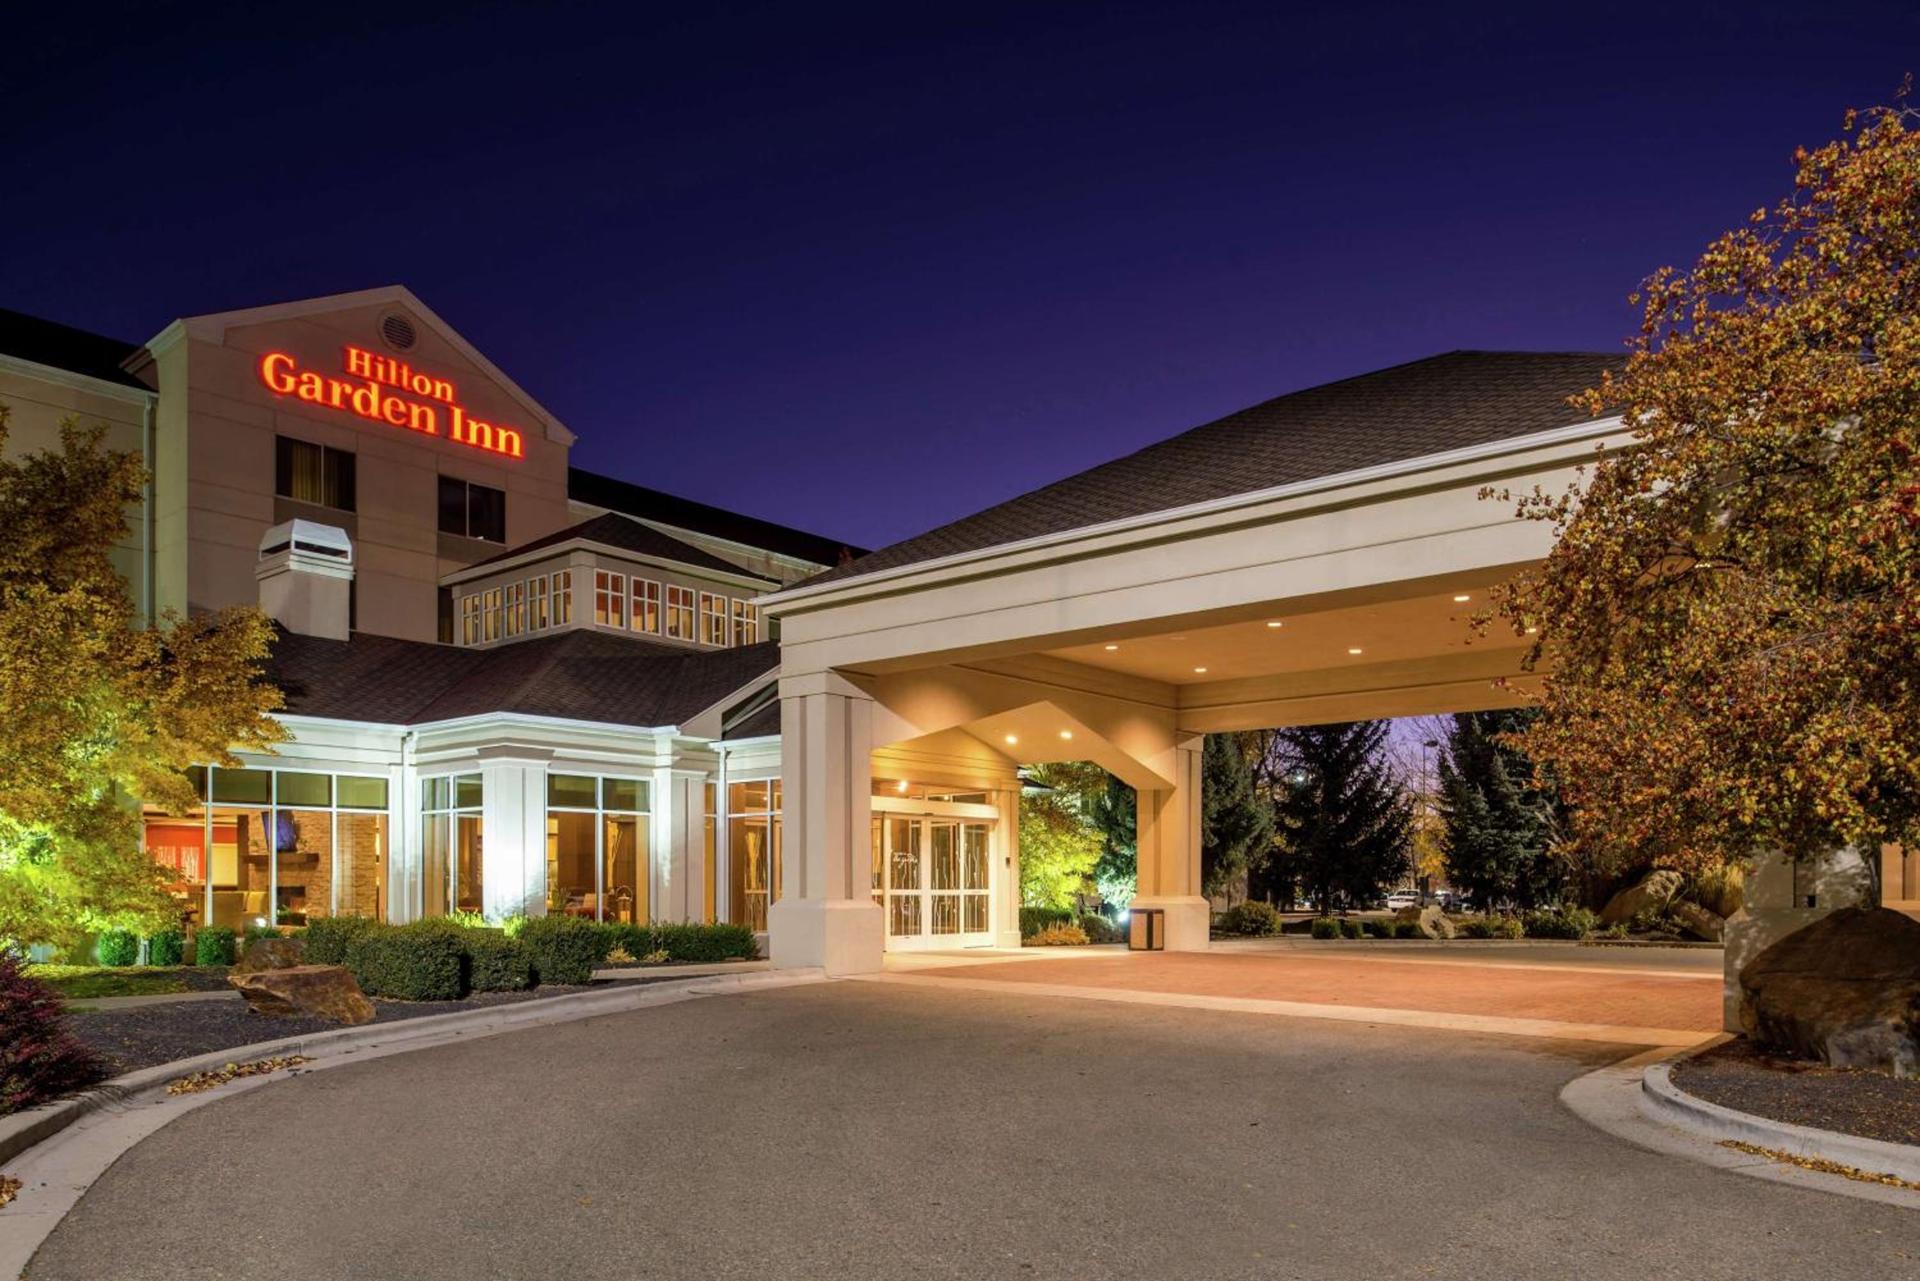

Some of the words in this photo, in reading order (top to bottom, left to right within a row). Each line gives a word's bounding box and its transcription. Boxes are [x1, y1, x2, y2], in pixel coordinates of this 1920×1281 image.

[260, 352, 438, 435] Garden
[450, 404, 524, 458] Inn
[346, 346, 455, 402] Hilton
